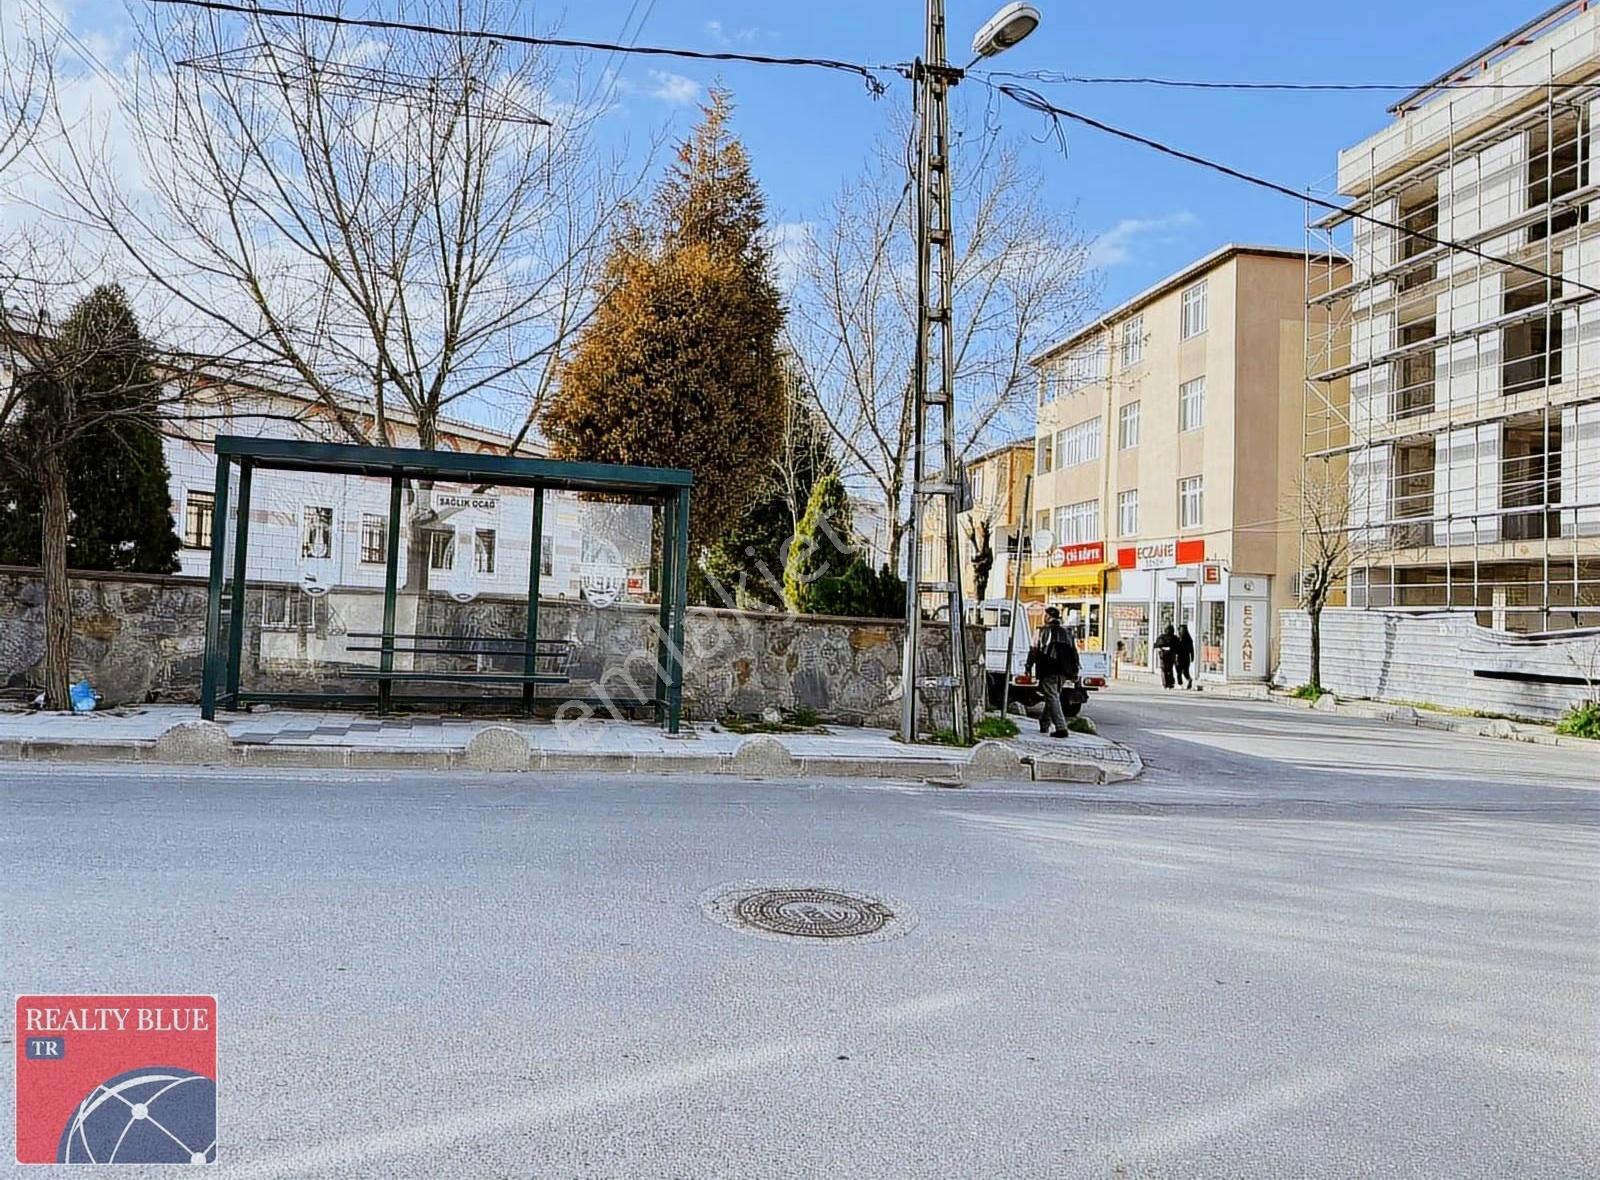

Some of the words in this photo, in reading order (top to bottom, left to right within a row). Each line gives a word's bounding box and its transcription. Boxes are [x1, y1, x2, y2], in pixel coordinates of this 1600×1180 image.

[1137, 544, 1174, 560] ECZANE
[1206, 567, 1217, 581] E
[1242, 605, 1253, 672] ECZANE
